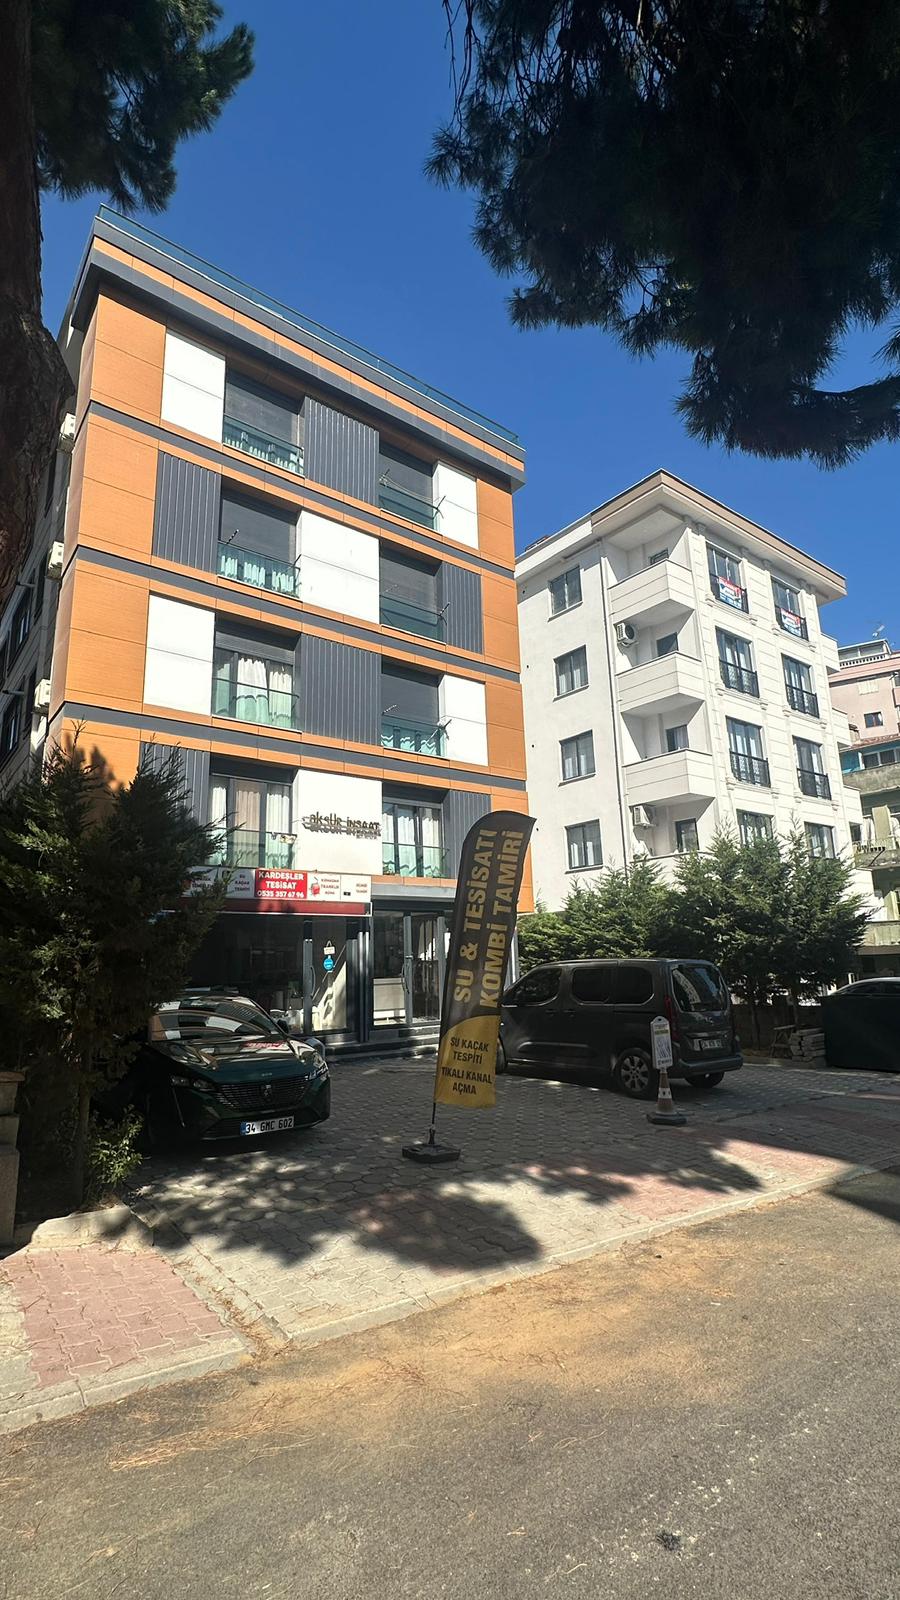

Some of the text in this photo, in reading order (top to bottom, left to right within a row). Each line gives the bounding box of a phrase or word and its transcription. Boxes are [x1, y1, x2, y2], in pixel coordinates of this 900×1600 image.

[258, 872, 304, 881] KARDEŞLER
[266, 880, 296, 888] TESİSAT
[257, 890, 274, 898] 0535
[454, 829, 498, 1002] SU & TESİSATI
[479, 830, 524, 1008] KOMBİ TAMİRİ
[450, 1037, 460, 1047] SU
[453, 1050, 482, 1064] TESPİTİ
[442, 1066, 492, 1084] TIKALI KANAL
[452, 1082, 476, 1095] AÇMA
[246, 1118, 292, 1134] 34 GMC 602
